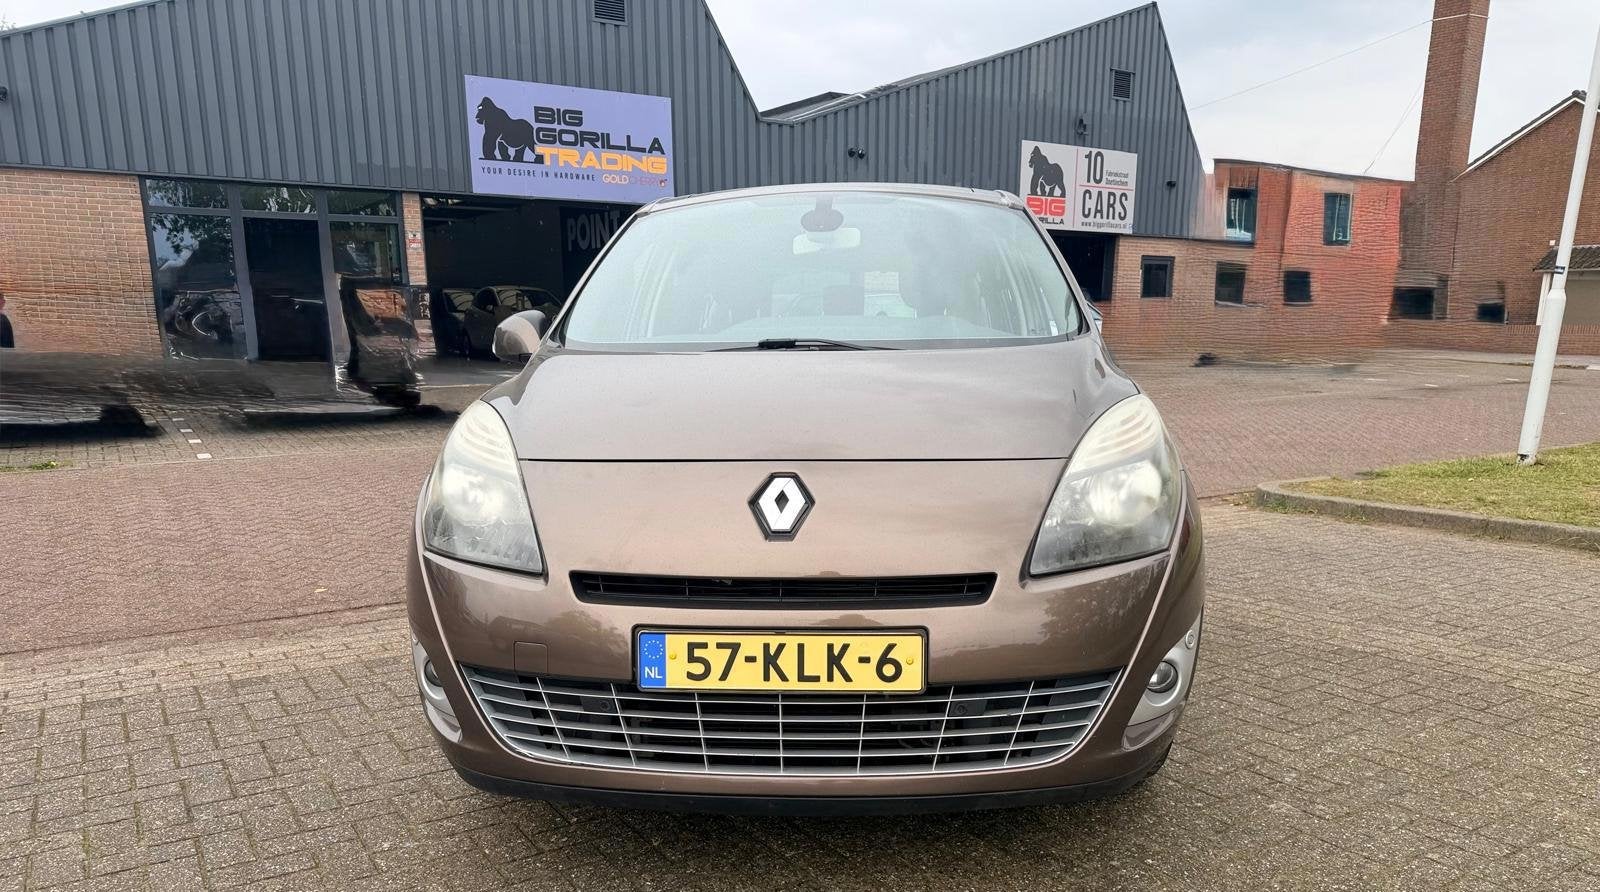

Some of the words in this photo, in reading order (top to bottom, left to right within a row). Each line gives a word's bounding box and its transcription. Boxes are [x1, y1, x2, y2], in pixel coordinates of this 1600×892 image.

[534, 106, 583, 127] BIG
[535, 127, 665, 155] GORILLA
[535, 147, 667, 175] TRADING
[1084, 150, 1104, 184] 10
[482, 166, 503, 175] YOUR
[507, 168, 536, 178] DESIRE
[541, 170, 549, 178] IN
[554, 171, 596, 182] HARDWARE
[1026, 196, 1066, 217] BIG
[1082, 189, 1128, 221] CARS
[1038, 216, 1065, 225] RILLA
[644, 666, 662, 679] NL
[686, 641, 903, 683] 57-KLK-6
